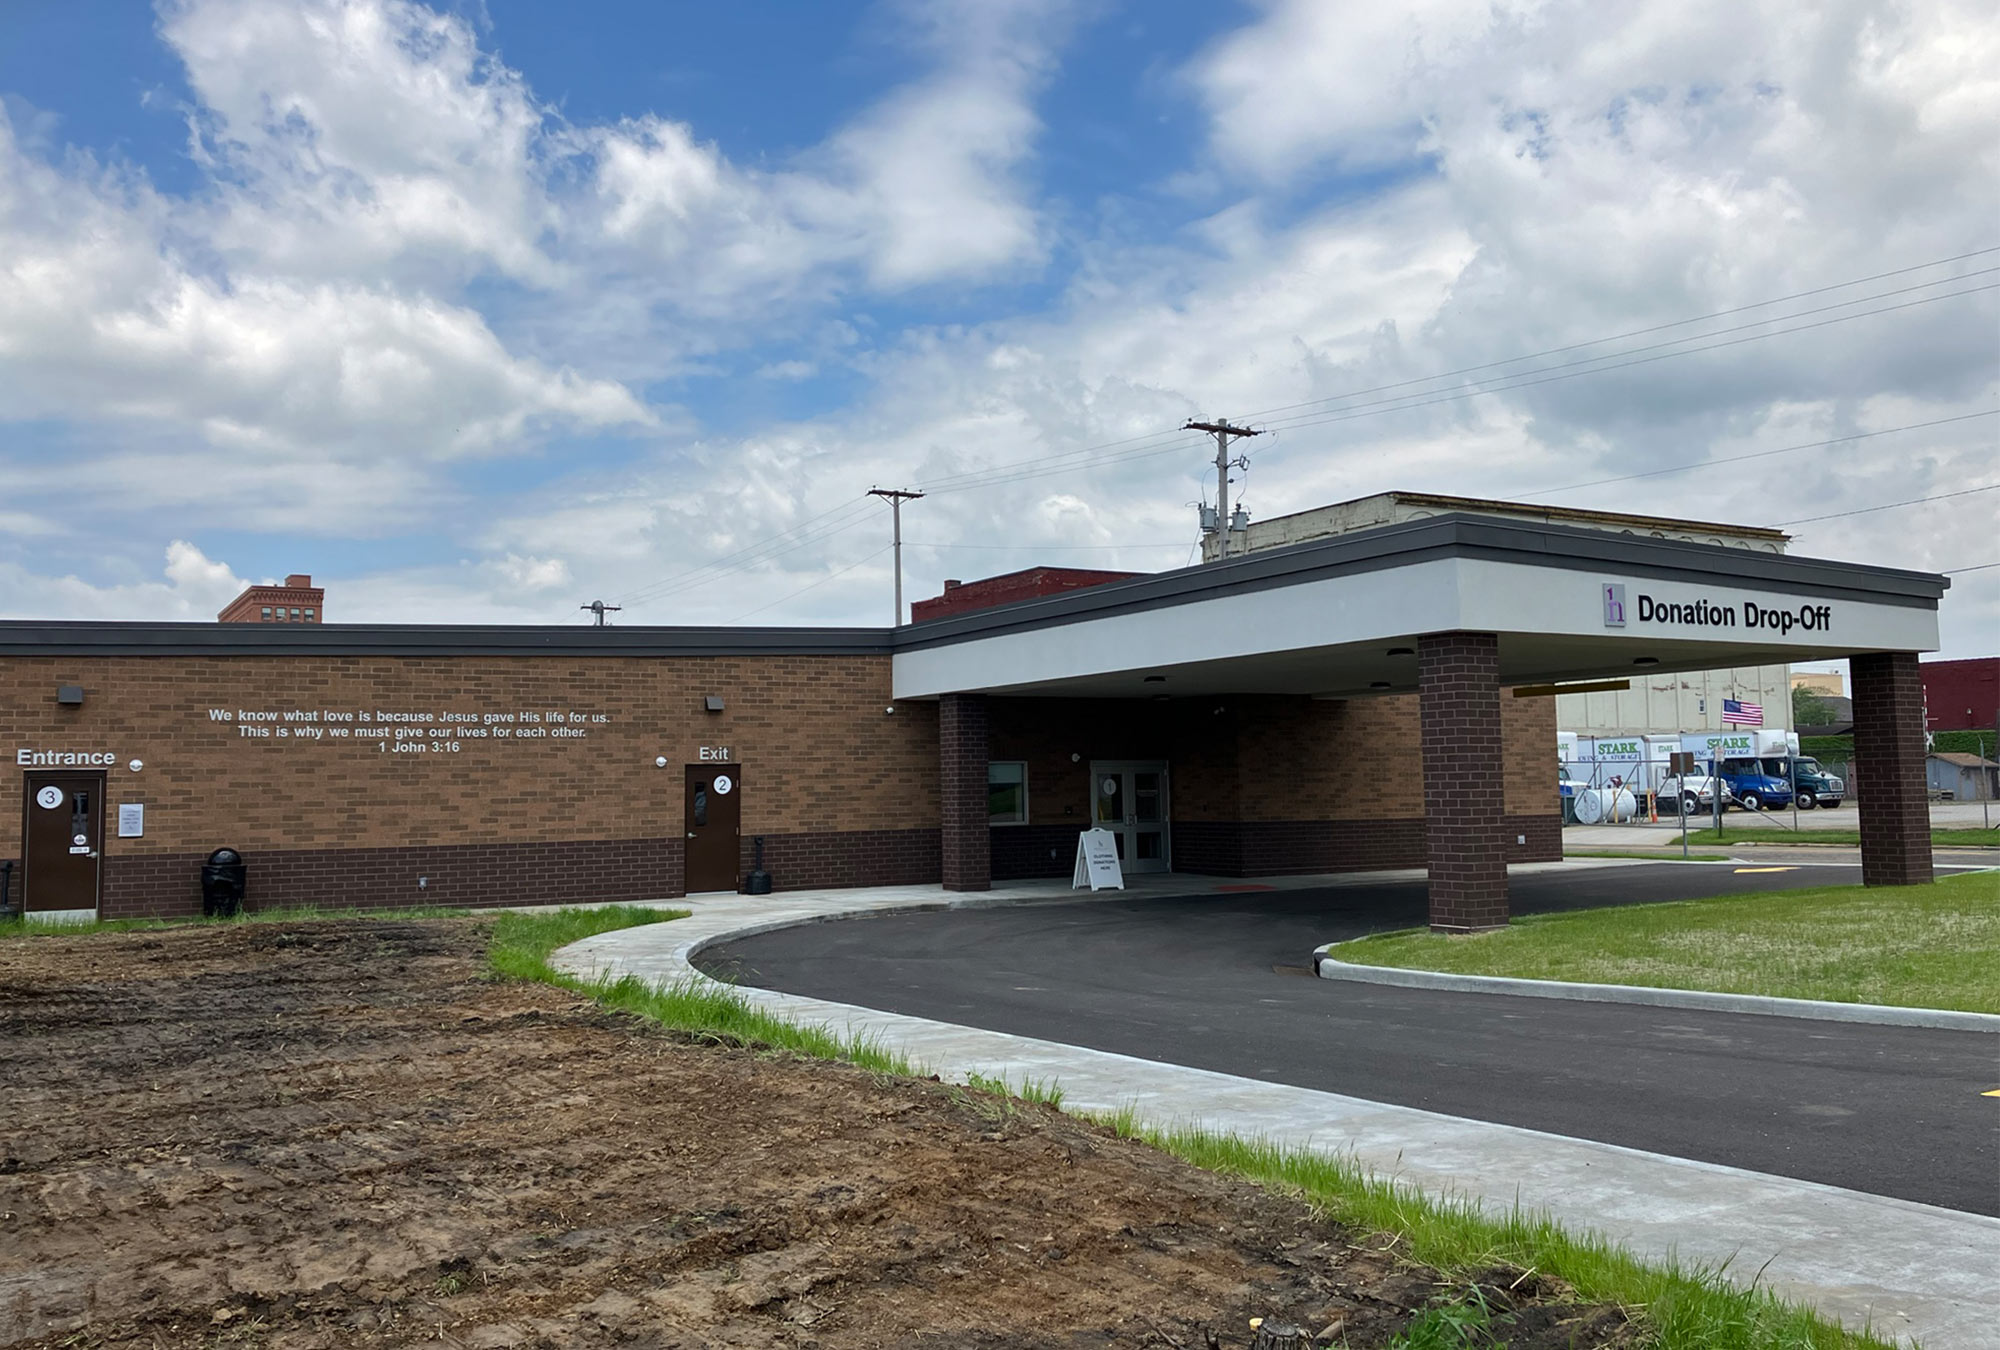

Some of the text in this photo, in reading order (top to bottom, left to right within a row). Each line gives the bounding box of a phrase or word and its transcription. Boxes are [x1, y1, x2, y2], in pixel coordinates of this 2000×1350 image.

[1637, 594, 1831, 636] Donation Drop-Off
[208, 709, 610, 726] We know what love is because Jesus gave His life for us.
[237, 725, 586, 741] This is why we must give our lives for each other.
[379, 741, 460, 753] 1 John 3:16
[1598, 742, 1639, 755] STARK
[1707, 736, 1751, 750] STARK
[16, 748, 116, 766] Entrance
[699, 746, 729, 760] Exit
[719, 779, 727, 791] 2
[45, 790, 55, 805] 3
